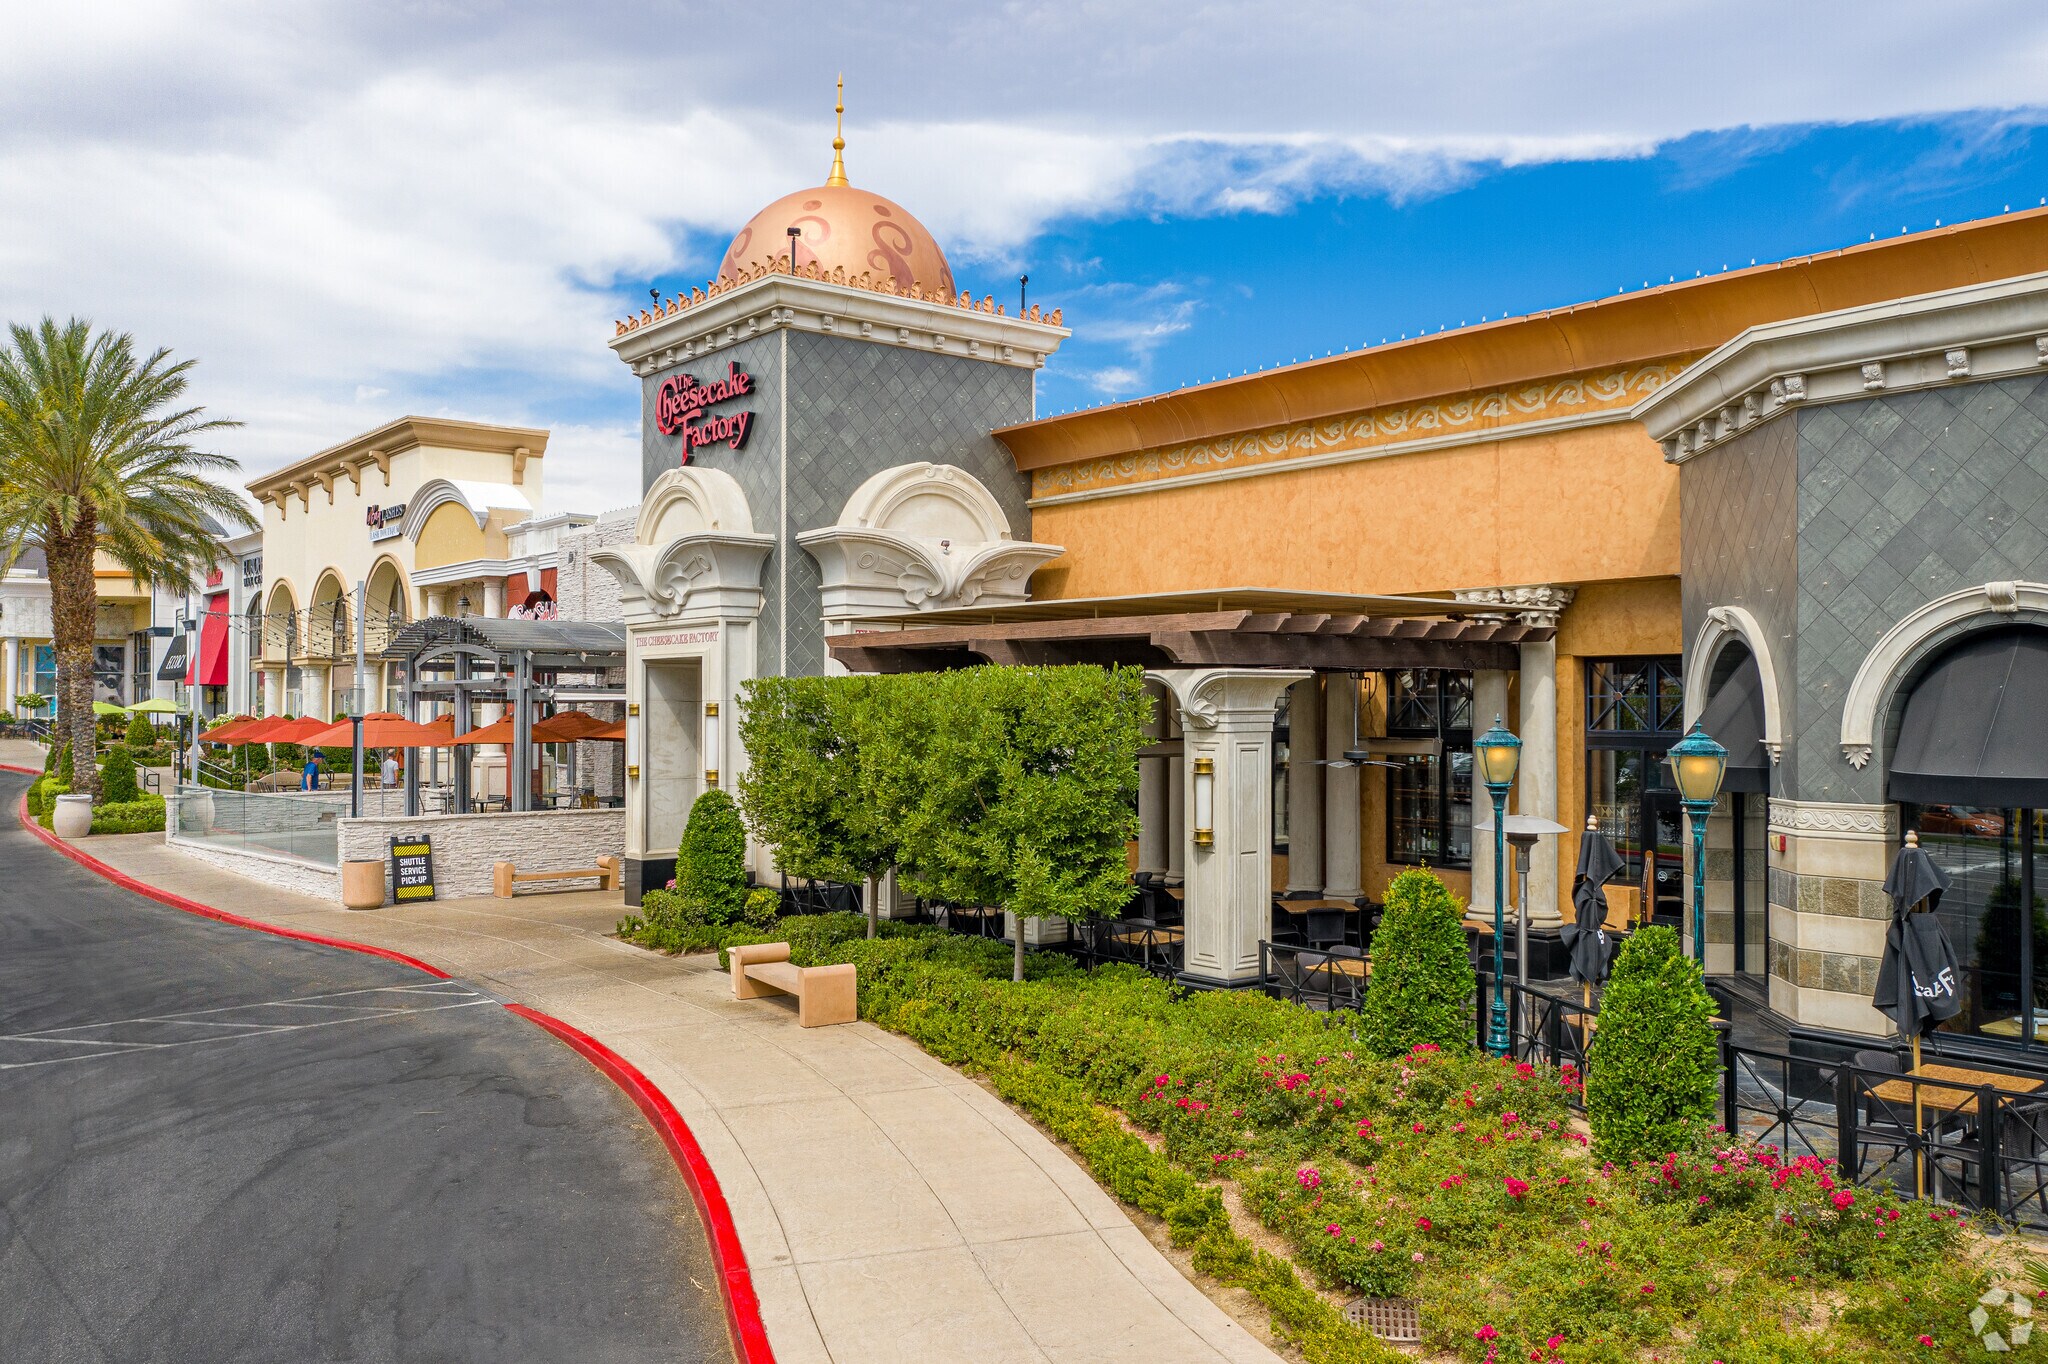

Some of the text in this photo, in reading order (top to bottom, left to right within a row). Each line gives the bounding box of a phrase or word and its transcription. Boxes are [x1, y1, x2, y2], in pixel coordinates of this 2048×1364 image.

[677, 373, 694, 390] The
[655, 361, 752, 436] Cheesecake
[673, 408, 751, 466] Factory
[635, 631, 719, 648] THE CHEESECAKE FACTORY
[399, 856, 426, 866] SHUTTLE
[400, 866, 427, 876] SERVICE
[401, 875, 428, 885] PICK-UP
